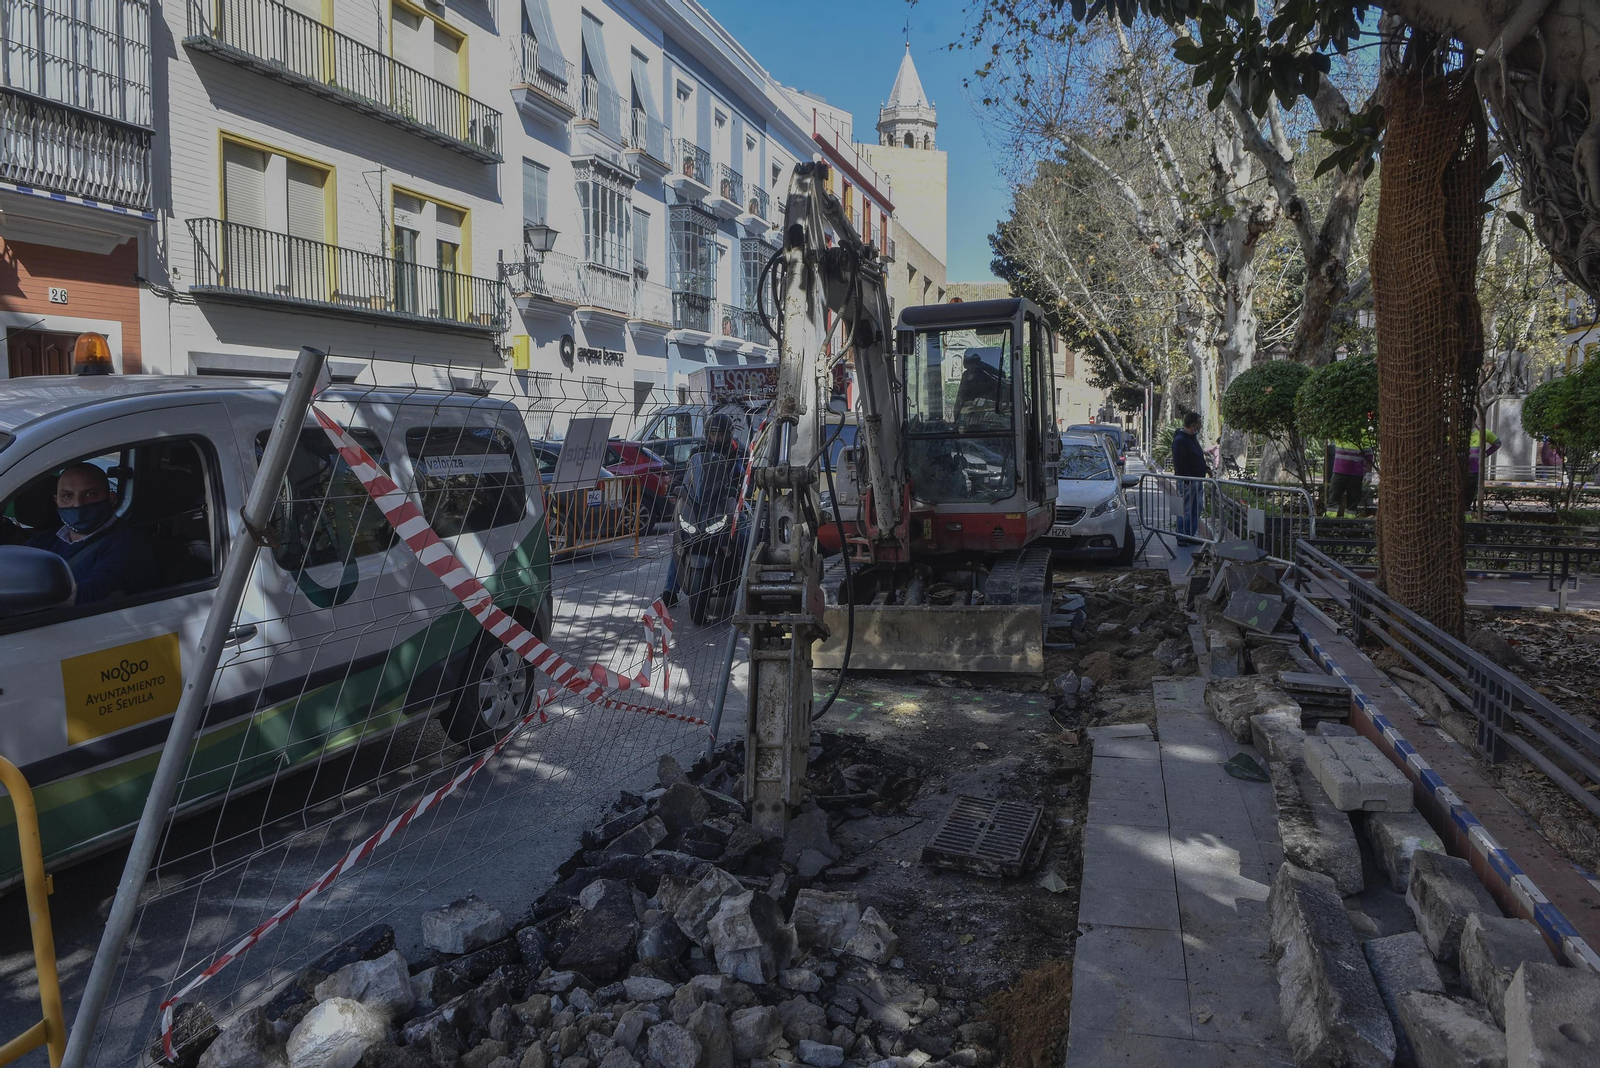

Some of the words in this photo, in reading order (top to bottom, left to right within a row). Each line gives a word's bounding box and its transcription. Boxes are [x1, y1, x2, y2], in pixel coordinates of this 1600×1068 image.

[51, 288, 67, 303] 26
[427, 456, 464, 470] valoriza
[1051, 528, 1067, 537] HZK
[85, 675, 165, 706] AYUNTAMIENTO
[98, 703, 113, 716] DE
[116, 691, 154, 711] SEVILLA
